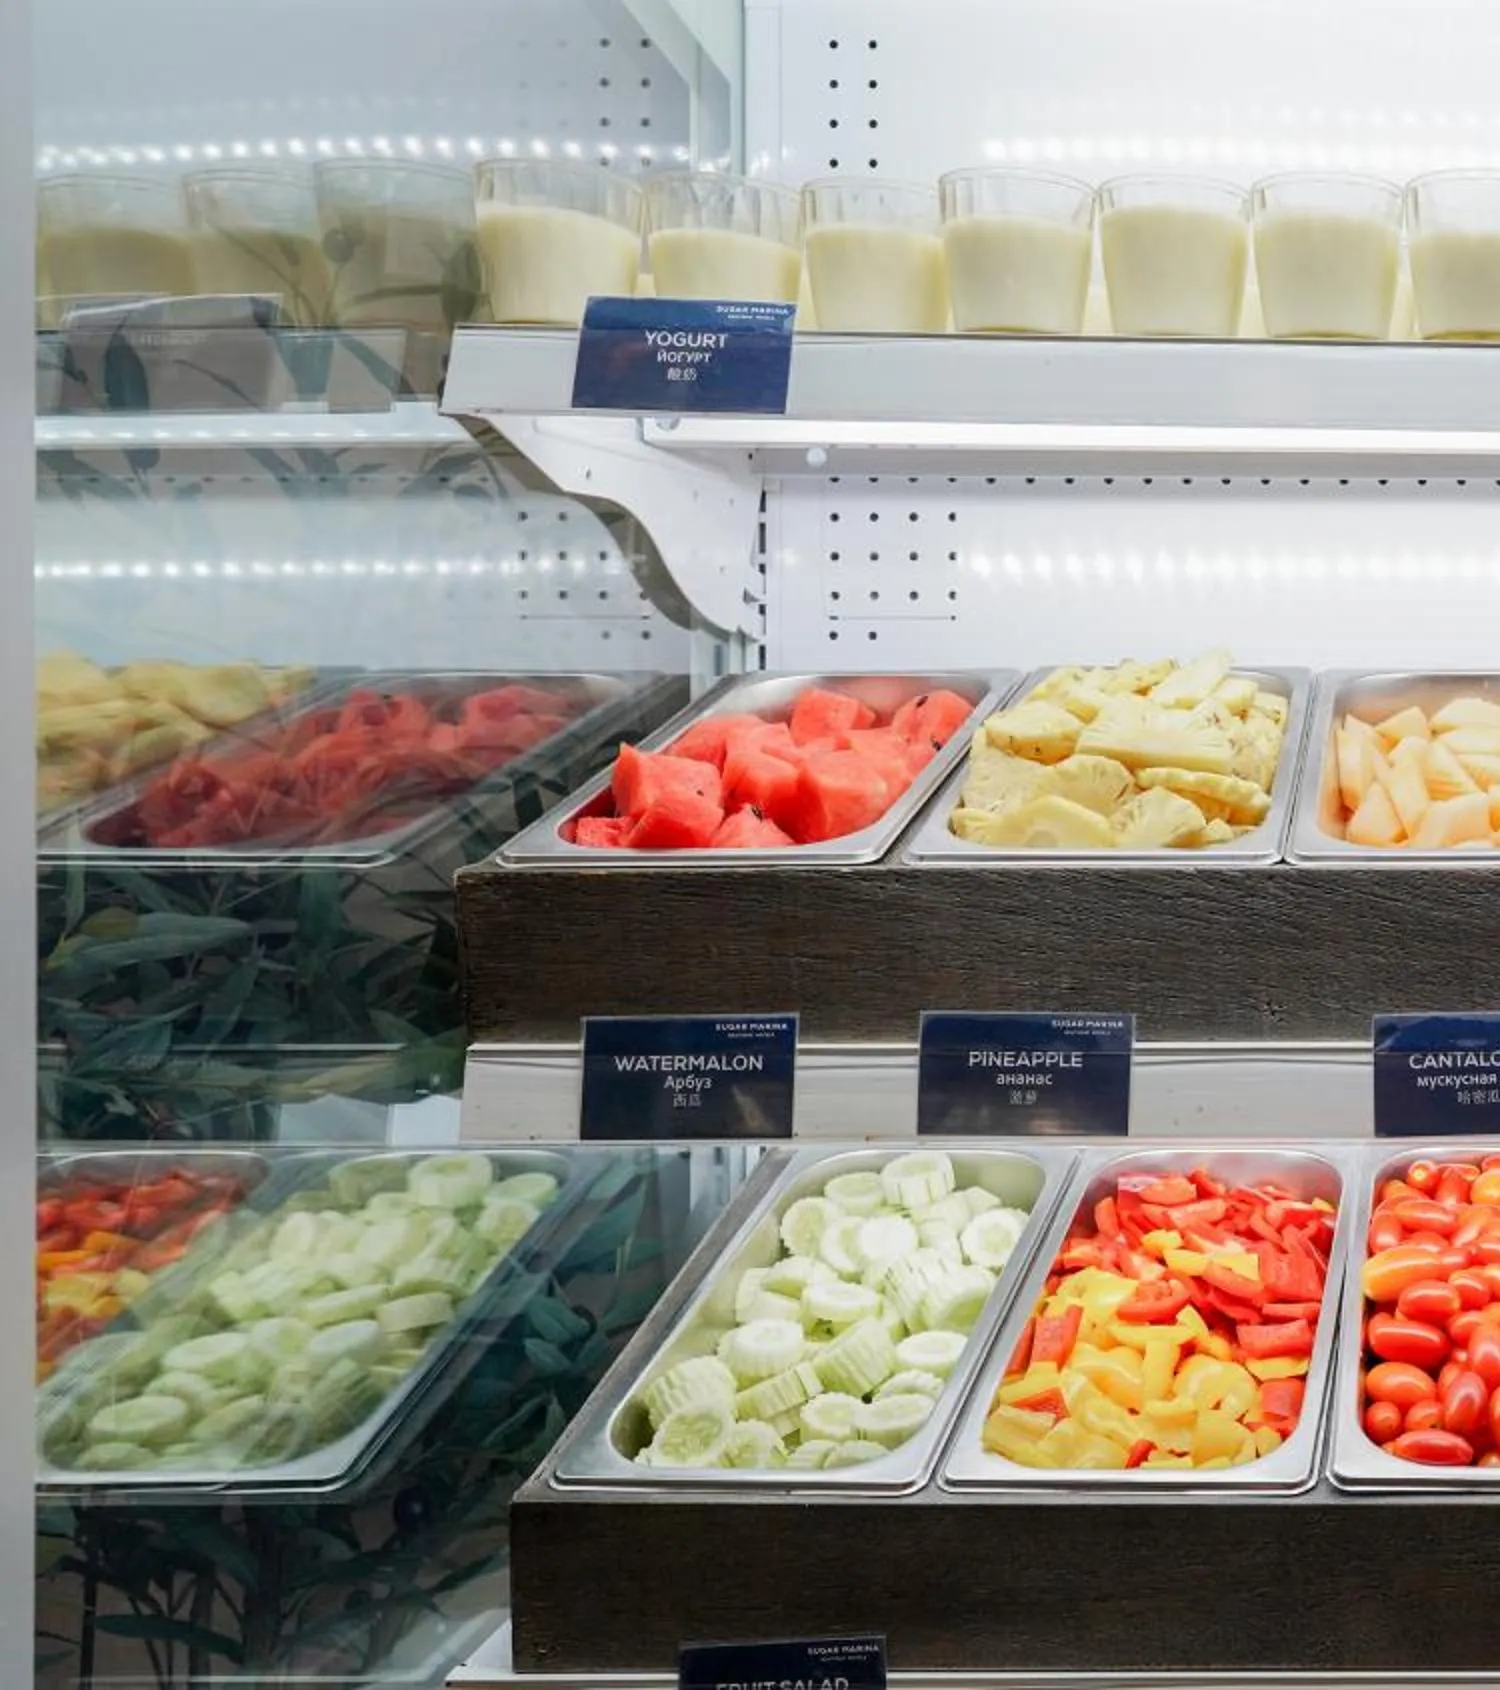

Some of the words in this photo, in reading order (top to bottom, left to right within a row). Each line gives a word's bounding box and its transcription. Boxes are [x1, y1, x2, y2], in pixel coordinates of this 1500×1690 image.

[645, 330, 728, 348] YOGURT
[614, 1055, 764, 1072] WATERMALON
[968, 1051, 1084, 1068] PINEAPPLE
[664, 1075, 713, 1091] Арбуз
[996, 1073, 1053, 1085] ананас
[1416, 1073, 1498, 1090] мускусная
